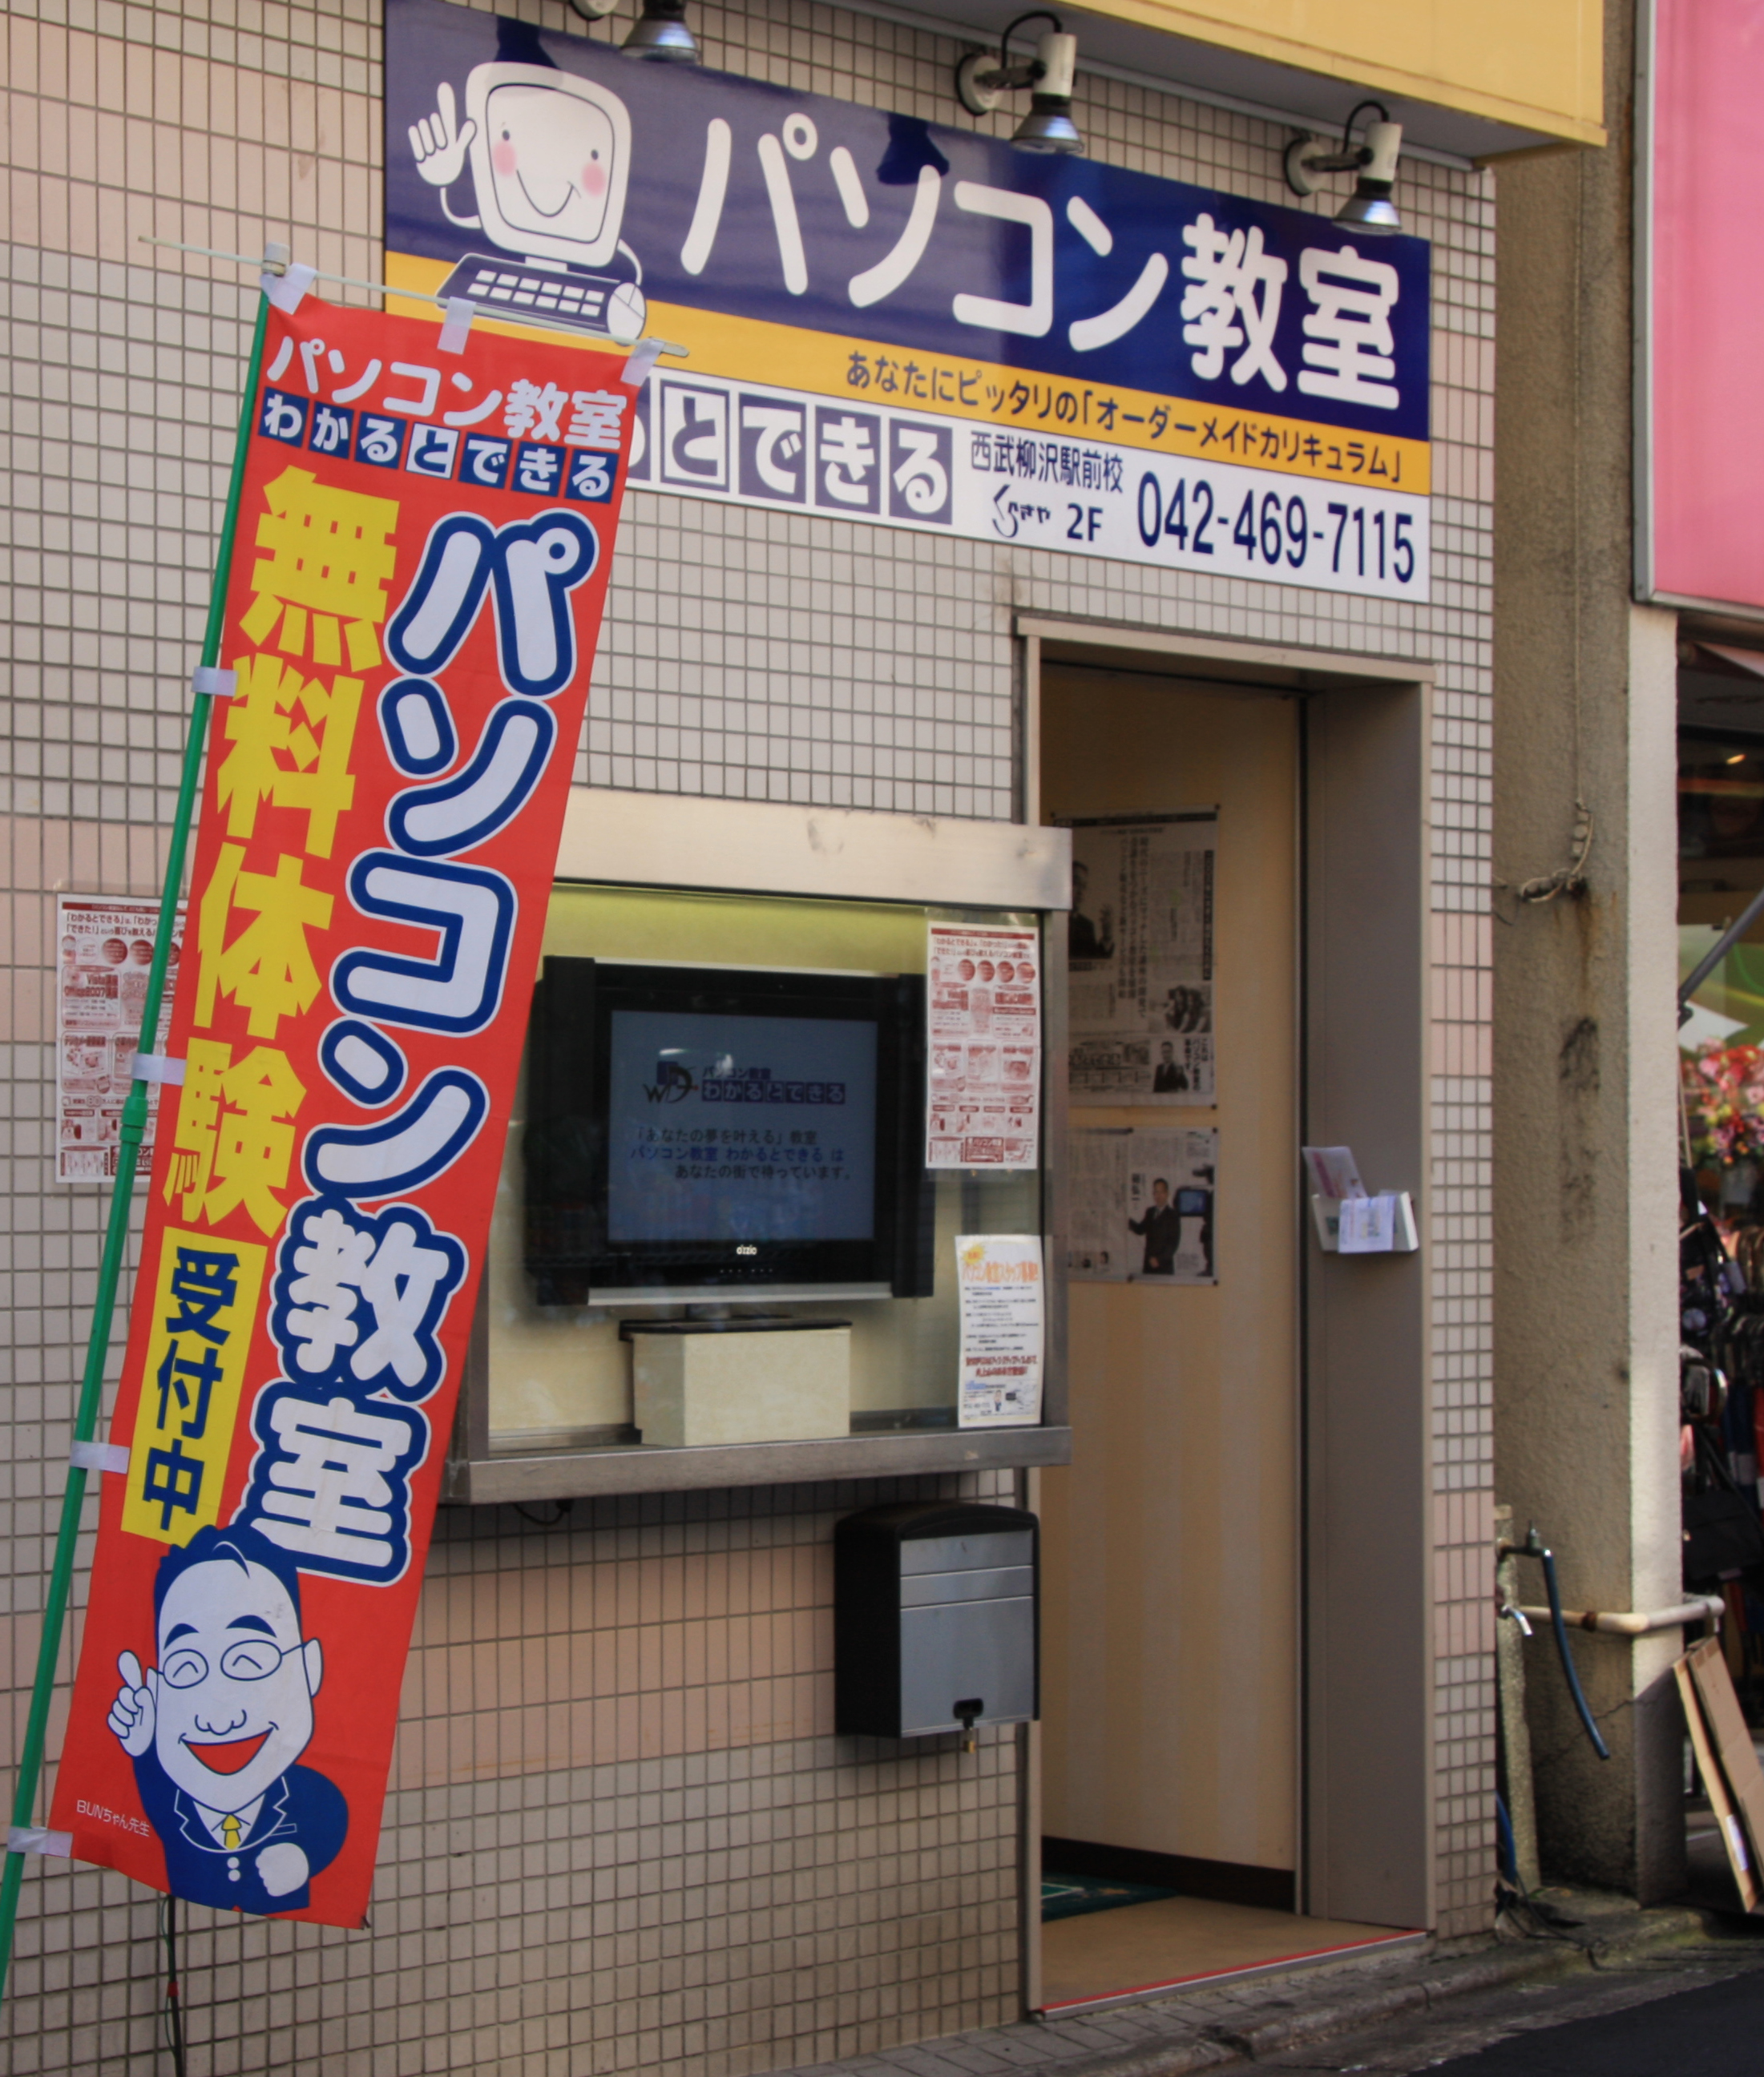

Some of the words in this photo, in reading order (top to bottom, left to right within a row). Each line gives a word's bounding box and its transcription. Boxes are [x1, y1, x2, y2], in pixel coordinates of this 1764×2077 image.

[680, 112, 1399, 410] パソコン教室
[261, 390, 615, 500] わかるとできる
[266, 336, 628, 450] パソコン教室
[846, 351, 1401, 482] あなたにピッタリの「オーダーメイドカリキュラム」
[971, 430, 1123, 494] 西武柳沢駅前校
[1067, 502, 1104, 542] 2F
[1138, 470, 1415, 583] 042-469-7115
[162, 465, 399, 1239] 無料体験
[232, 509, 599, 1587] パソコン教室
[702, 1079, 846, 1104] わかるとできる
[726, 1147, 823, 1163] わかるとできる
[142, 1246, 240, 1531] 受付中
[76, 1799, 150, 1837] BUNちゃん先生
